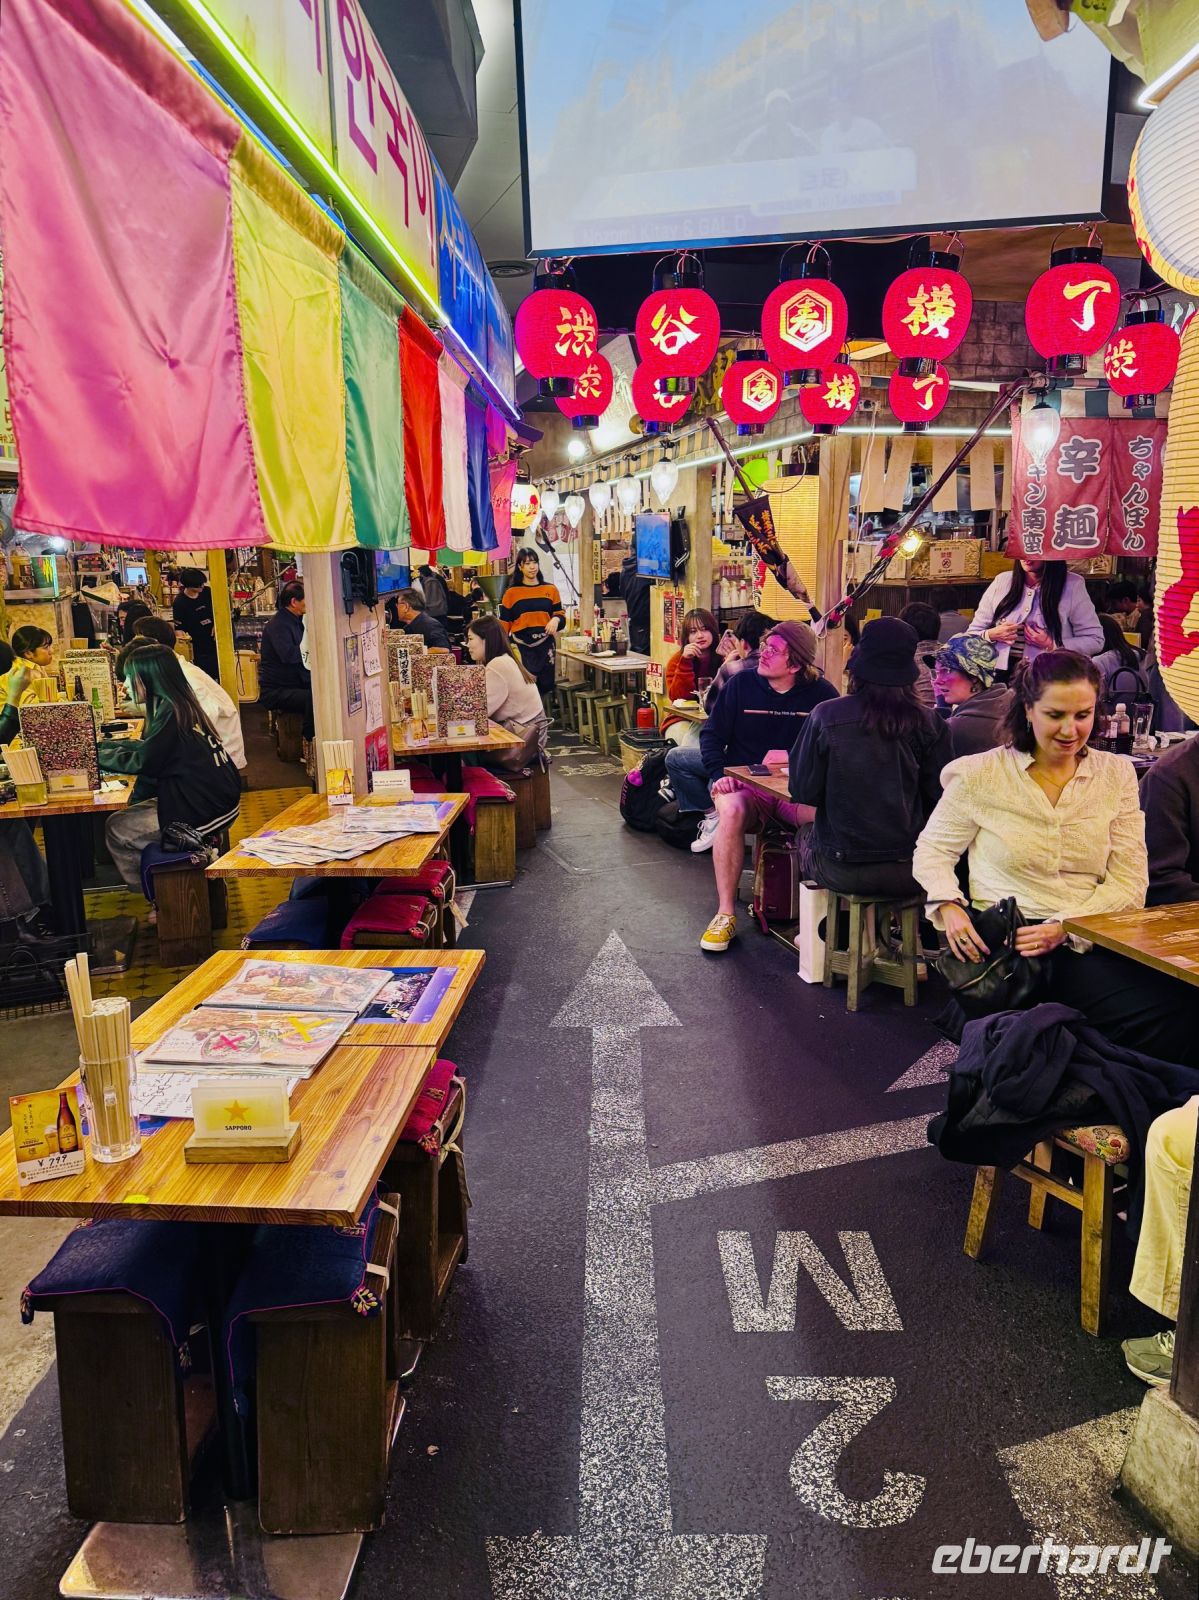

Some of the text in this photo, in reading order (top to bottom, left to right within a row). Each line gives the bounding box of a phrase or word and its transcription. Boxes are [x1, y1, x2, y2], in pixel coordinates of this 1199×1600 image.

[555, 306, 596, 358] 渋
[650, 303, 701, 355] 谷
[901, 283, 956, 339] 横
[1104, 339, 1138, 380] 渋
[821, 372, 857, 410] 横
[1021, 465, 1048, 555] キン南蛮
[1121, 435, 1153, 551] ちゃんぽん
